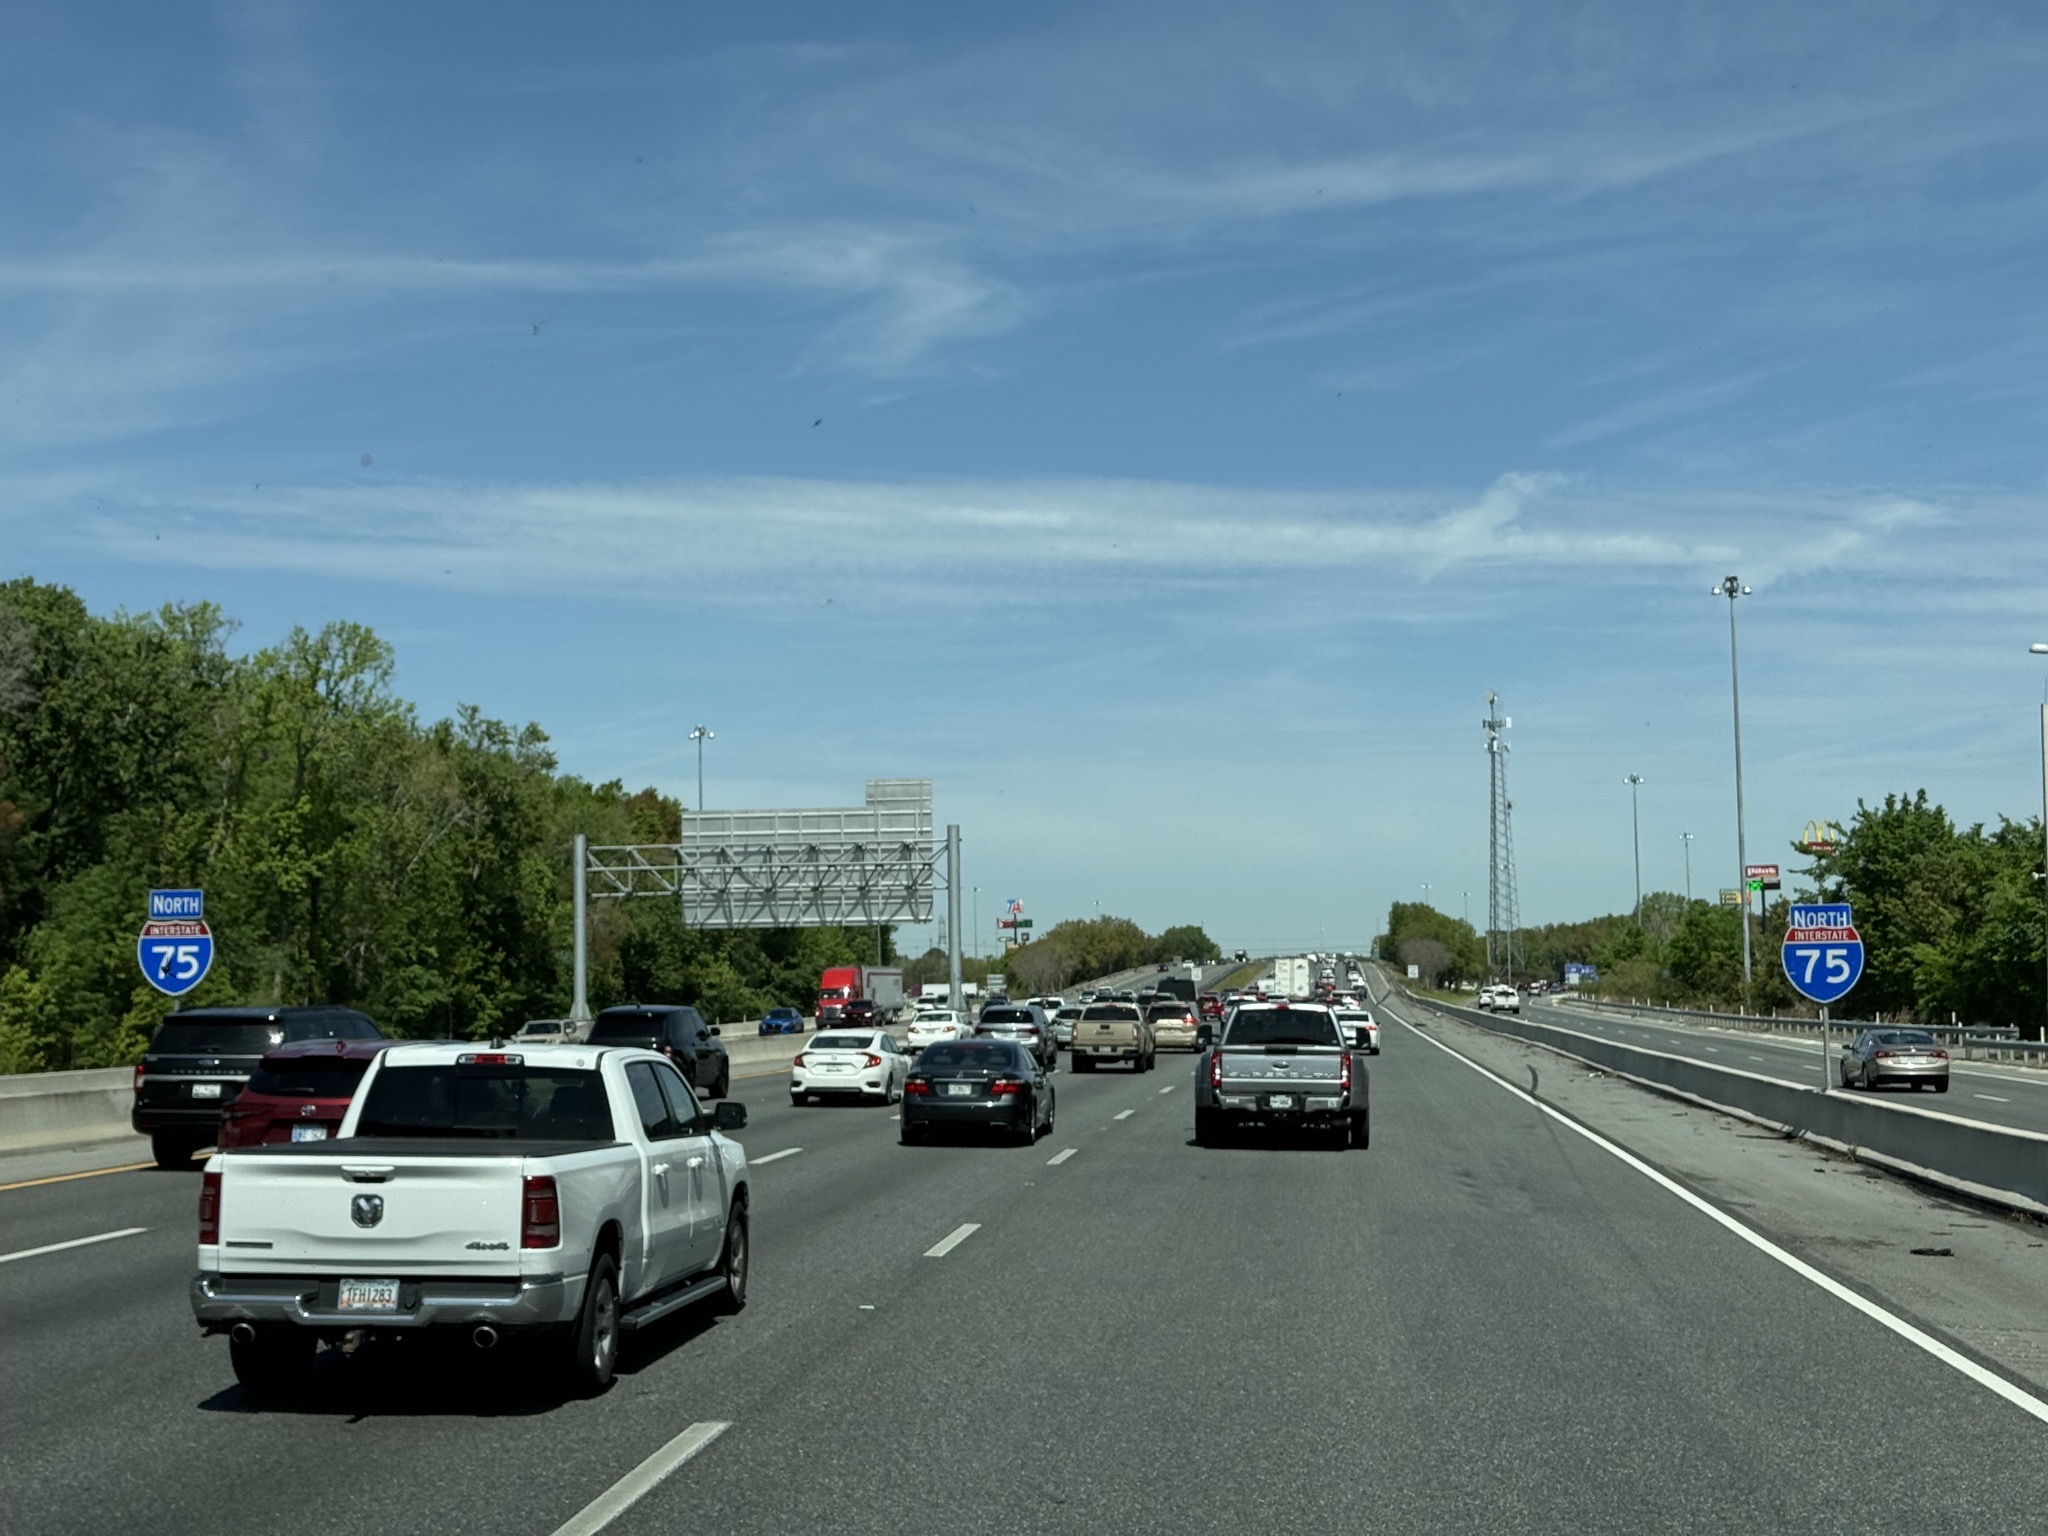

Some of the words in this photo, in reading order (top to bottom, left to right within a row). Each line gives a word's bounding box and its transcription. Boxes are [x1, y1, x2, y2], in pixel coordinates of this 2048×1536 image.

[153, 895, 199, 914] NORTH
[1794, 910, 1847, 928] NORTH
[150, 925, 201, 935] INTERSTATE
[1794, 930, 1849, 940] INTERSTATE
[151, 945, 199, 980] 75
[1795, 949, 1850, 984] 75
